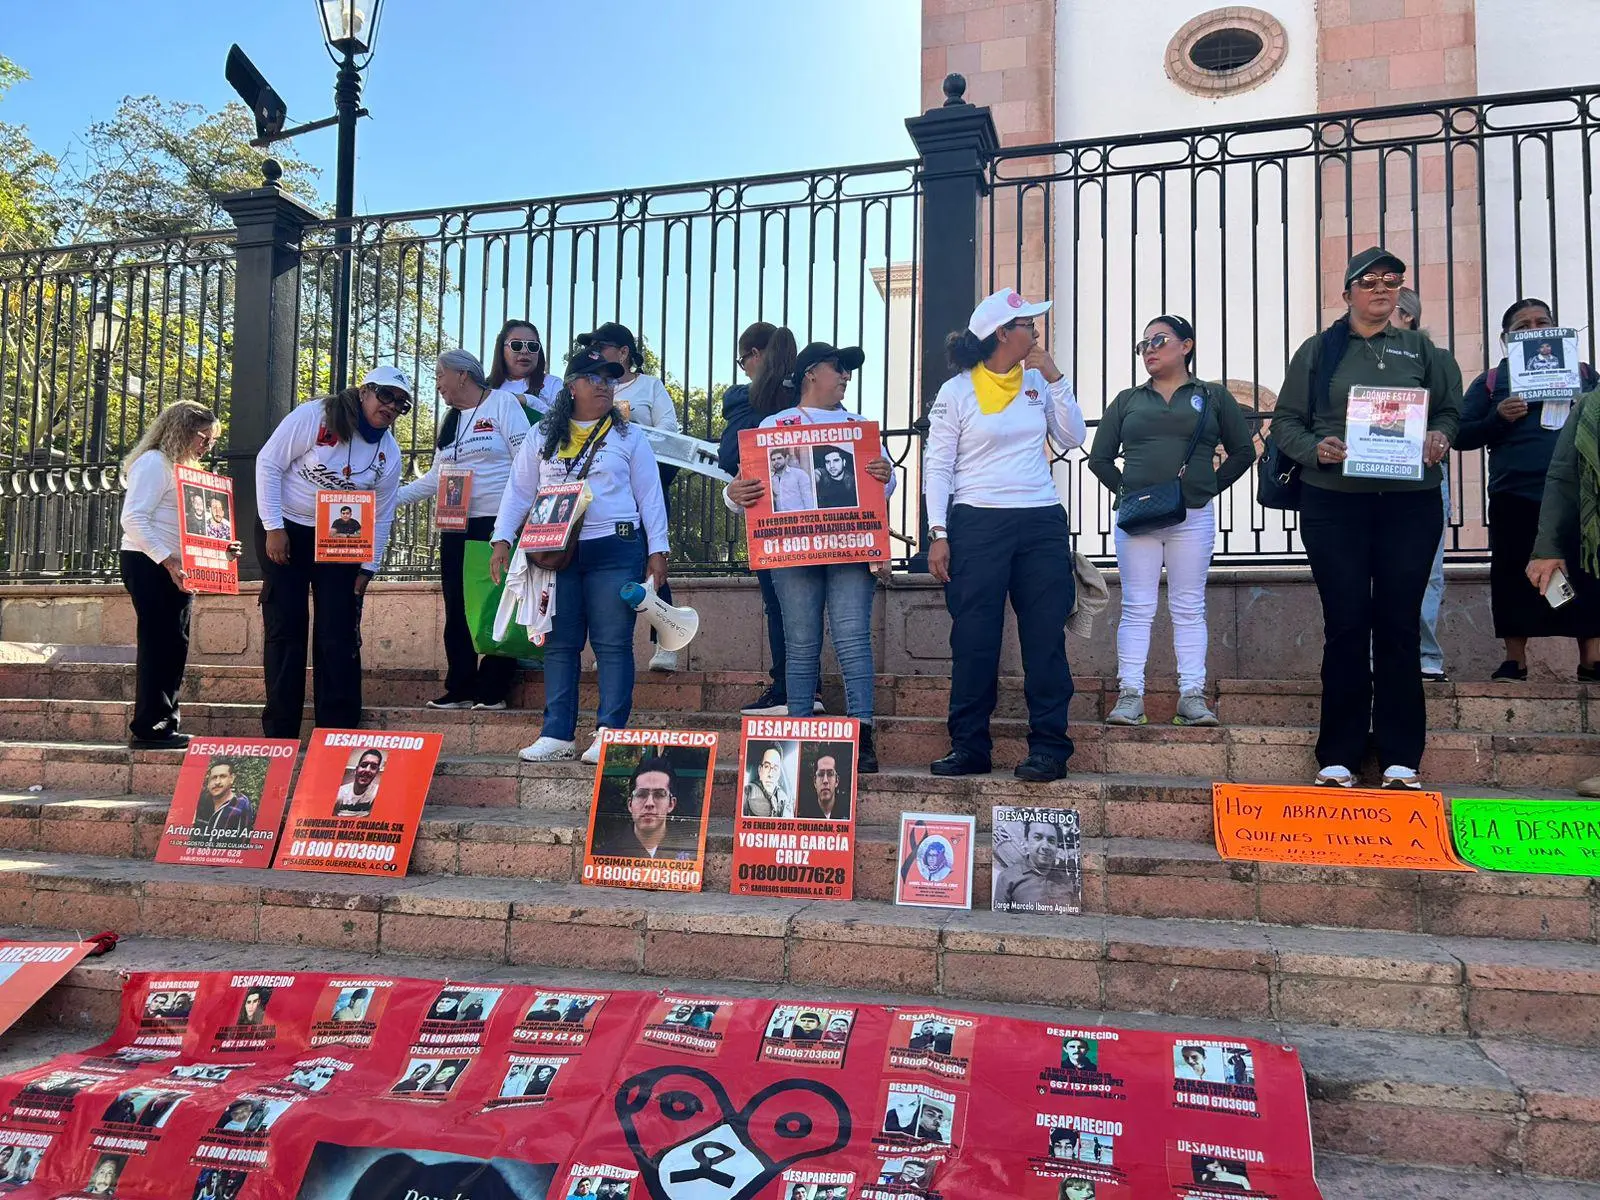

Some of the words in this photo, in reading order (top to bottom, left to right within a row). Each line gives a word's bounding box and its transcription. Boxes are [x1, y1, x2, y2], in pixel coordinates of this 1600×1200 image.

[1393, 391, 1416, 400] ESTÁ?
[1519, 389, 1572, 399] DESAPARECIDO
[757, 427, 863, 446] DESAPARECIDO
[1356, 463, 1412, 474] DESAPARECIDO
[178, 467, 233, 492] DESAPARECIDO
[540, 484, 581, 493] DESAPARECIDO
[320, 494, 372, 503] DESAPARECIDO
[757, 519, 765, 527] 11
[766, 516, 799, 526] FEBRERO
[753, 529, 783, 539] ALFONSO
[784, 526, 814, 537] ALBERTO
[815, 522, 856, 534] PALAZUELOS
[857, 521, 882, 531] MEDINA
[764, 538, 781, 554] 01
[782, 535, 811, 552] 800
[813, 532, 874, 550] 6703600
[768, 554, 806, 563] SABUESOS
[747, 720, 853, 738] DESAPARECIDO
[325, 733, 424, 750] DESAPARECIDO
[603, 731, 717, 746] DESAPARECIDO
[190, 743, 293, 757] DESAPARECIDO
[303, 819, 339, 828] NOVIEMBRE
[997, 810, 1075, 825] DESAPARECIDO
[1282, 805, 1392, 823] ABRAZAMOS
[1409, 810, 1427, 829] A
[166, 824, 200, 836] Arturo
[240, 828, 274, 840] Arana
[753, 821, 776, 830] ENERO
[1471, 818, 1500, 839] LA
[309, 829, 335, 840] MANUEL
[337, 831, 365, 841] MACIAS
[365, 832, 402, 844] MENDOZA
[738, 832, 797, 850] YOSIMAR
[800, 834, 849, 851] GARCÍA
[1235, 828, 1312, 843] QUIENES
[1324, 833, 1393, 846] TIENEN
[1411, 839, 1425, 849] A
[186, 847, 194, 855] 01
[212, 848, 225, 856] 077
[290, 840, 306, 856] 01
[306, 841, 333, 858] 800
[334, 843, 395, 861] 6703600
[775, 849, 810, 865] CRUZ
[1491, 845, 1514, 855] DE
[1529, 847, 1566, 857] UNA
[289, 859, 323, 867] SABUESOS
[593, 857, 632, 867] YOSIMAR
[634, 858, 668, 869] GARCIA
[669, 861, 694, 870] CRUZ
[584, 864, 700, 885] 018006703600
[738, 864, 846, 884] 01800077628
[596, 878, 627, 887] SABUESOS
[751, 884, 779, 893] SABUESOS
[994, 900, 1010, 912] Jorge
[1011, 901, 1034, 910] Marcelo
[1035, 902, 1053, 911] Ibarra
[1054, 903, 1079, 914] Aguilera
[149, 981, 200, 989] DESAPARECIDO
[231, 975, 295, 988] DESAPARECIDO
[329, 980, 394, 988] DESAPARECIDO
[534, 991, 605, 1001] DESAPARECIDO
[664, 997, 733, 1006] DESAPARECIDO
[779, 1005, 853, 1015] DESAPARECIDO
[899, 1013, 973, 1027] DESAPARECIDO
[420, 1033, 429, 1042] 01
[513, 1029, 539, 1040] 6673
[540, 1032, 554, 1041] 29
[1046, 1027, 1119, 1041] DESAPARECIDO
[410, 1046, 480, 1055] DESAPARECIDOS
[508, 1055, 569, 1065] DESAPARECIDO
[889, 1082, 956, 1103] DESAPARECIDO
[1070, 1082, 1086, 1090] 157
[1088, 1084, 1111, 1092] 1930
[1177, 1092, 1188, 1103] 01
[1190, 1093, 1209, 1106] 800
[1211, 1096, 1256, 1112] 6703600
[1036, 1113, 1123, 1136] DESAPARECIDO
[0, 1130, 52, 1148] ESAPARECIDO
[94, 1135, 105, 1145] 01
[196, 1145, 207, 1157] 01
[207, 1146, 228, 1159] 800
[228, 1148, 268, 1162] 6703600
[1177, 1140, 1265, 1163] DESAPARECIDA
[571, 1163, 640, 1179] DESAPARECIDO
[782, 1169, 855, 1184] DESAPARECIDO
[861, 1189, 873, 1198] 01
